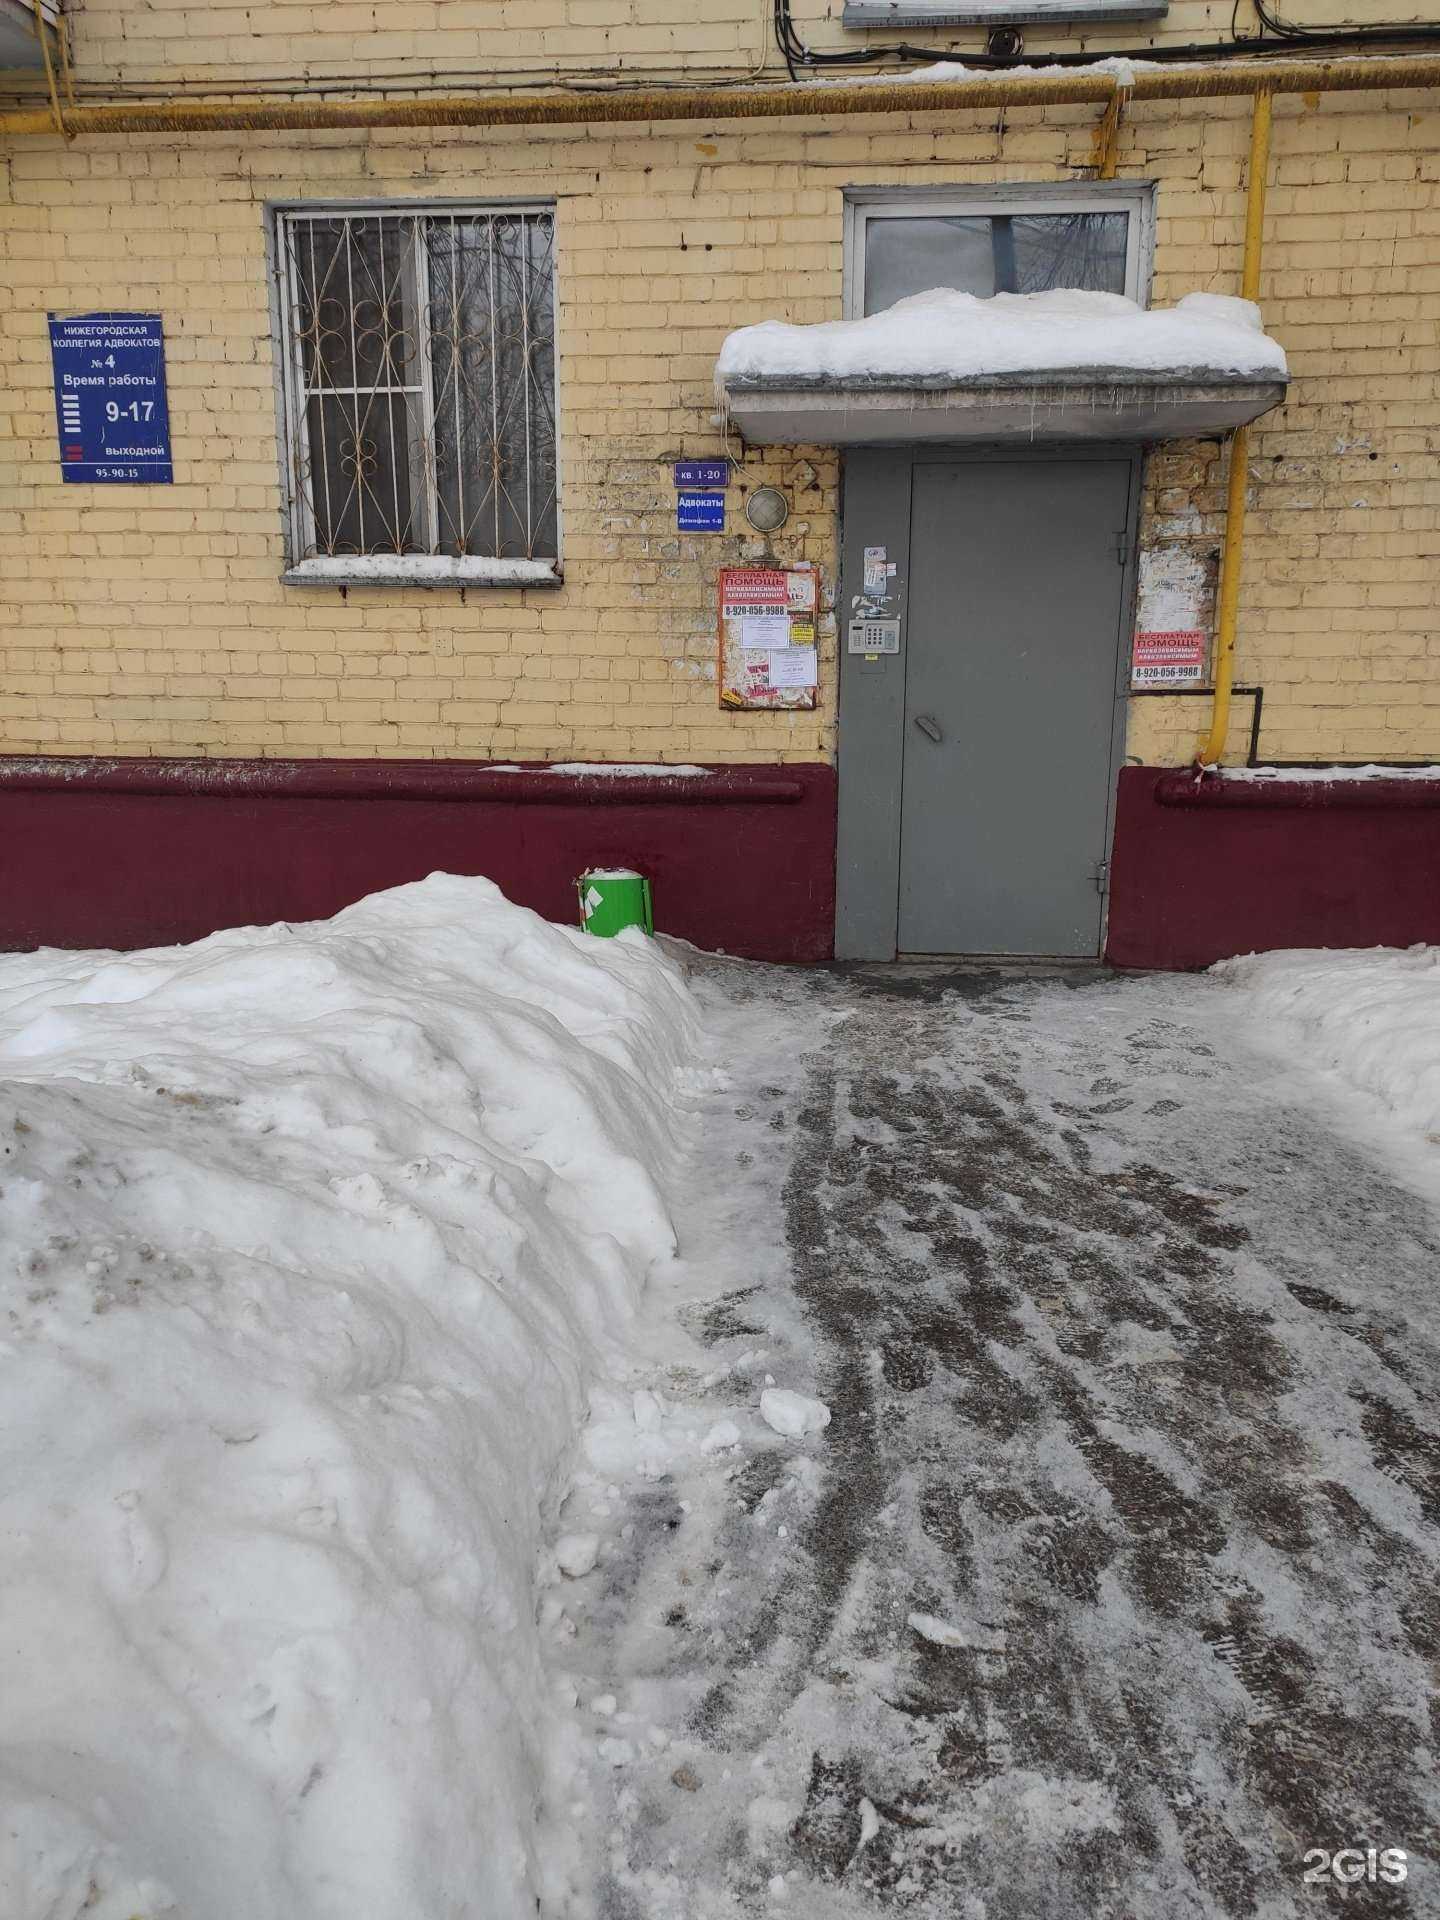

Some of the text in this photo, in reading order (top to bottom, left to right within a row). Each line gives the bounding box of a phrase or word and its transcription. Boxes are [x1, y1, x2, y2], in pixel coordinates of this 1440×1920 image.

[64, 326, 148, 336] НИЖЕГОРОДСКАЯ
[53, 338, 161, 349] КОЛЛЕГИЯ АДВОКАТОВ
[90, 354, 116, 369] № 4
[63, 374, 157, 388] Время работы
[105, 401, 154, 422] 9-17
[95, 468, 138, 478] 95-90-15
[698, 470, 720, 479] 1-20
[679, 497, 724, 508] Адвокаты
[725, 578, 785, 586] ПОМОЩЬ
[725, 605, 785, 616] 8-920-056-9988
[1137, 639, 1200, 648] ПОМОЩЬ
[1136, 666, 1199, 678] 8-920-056-9988
